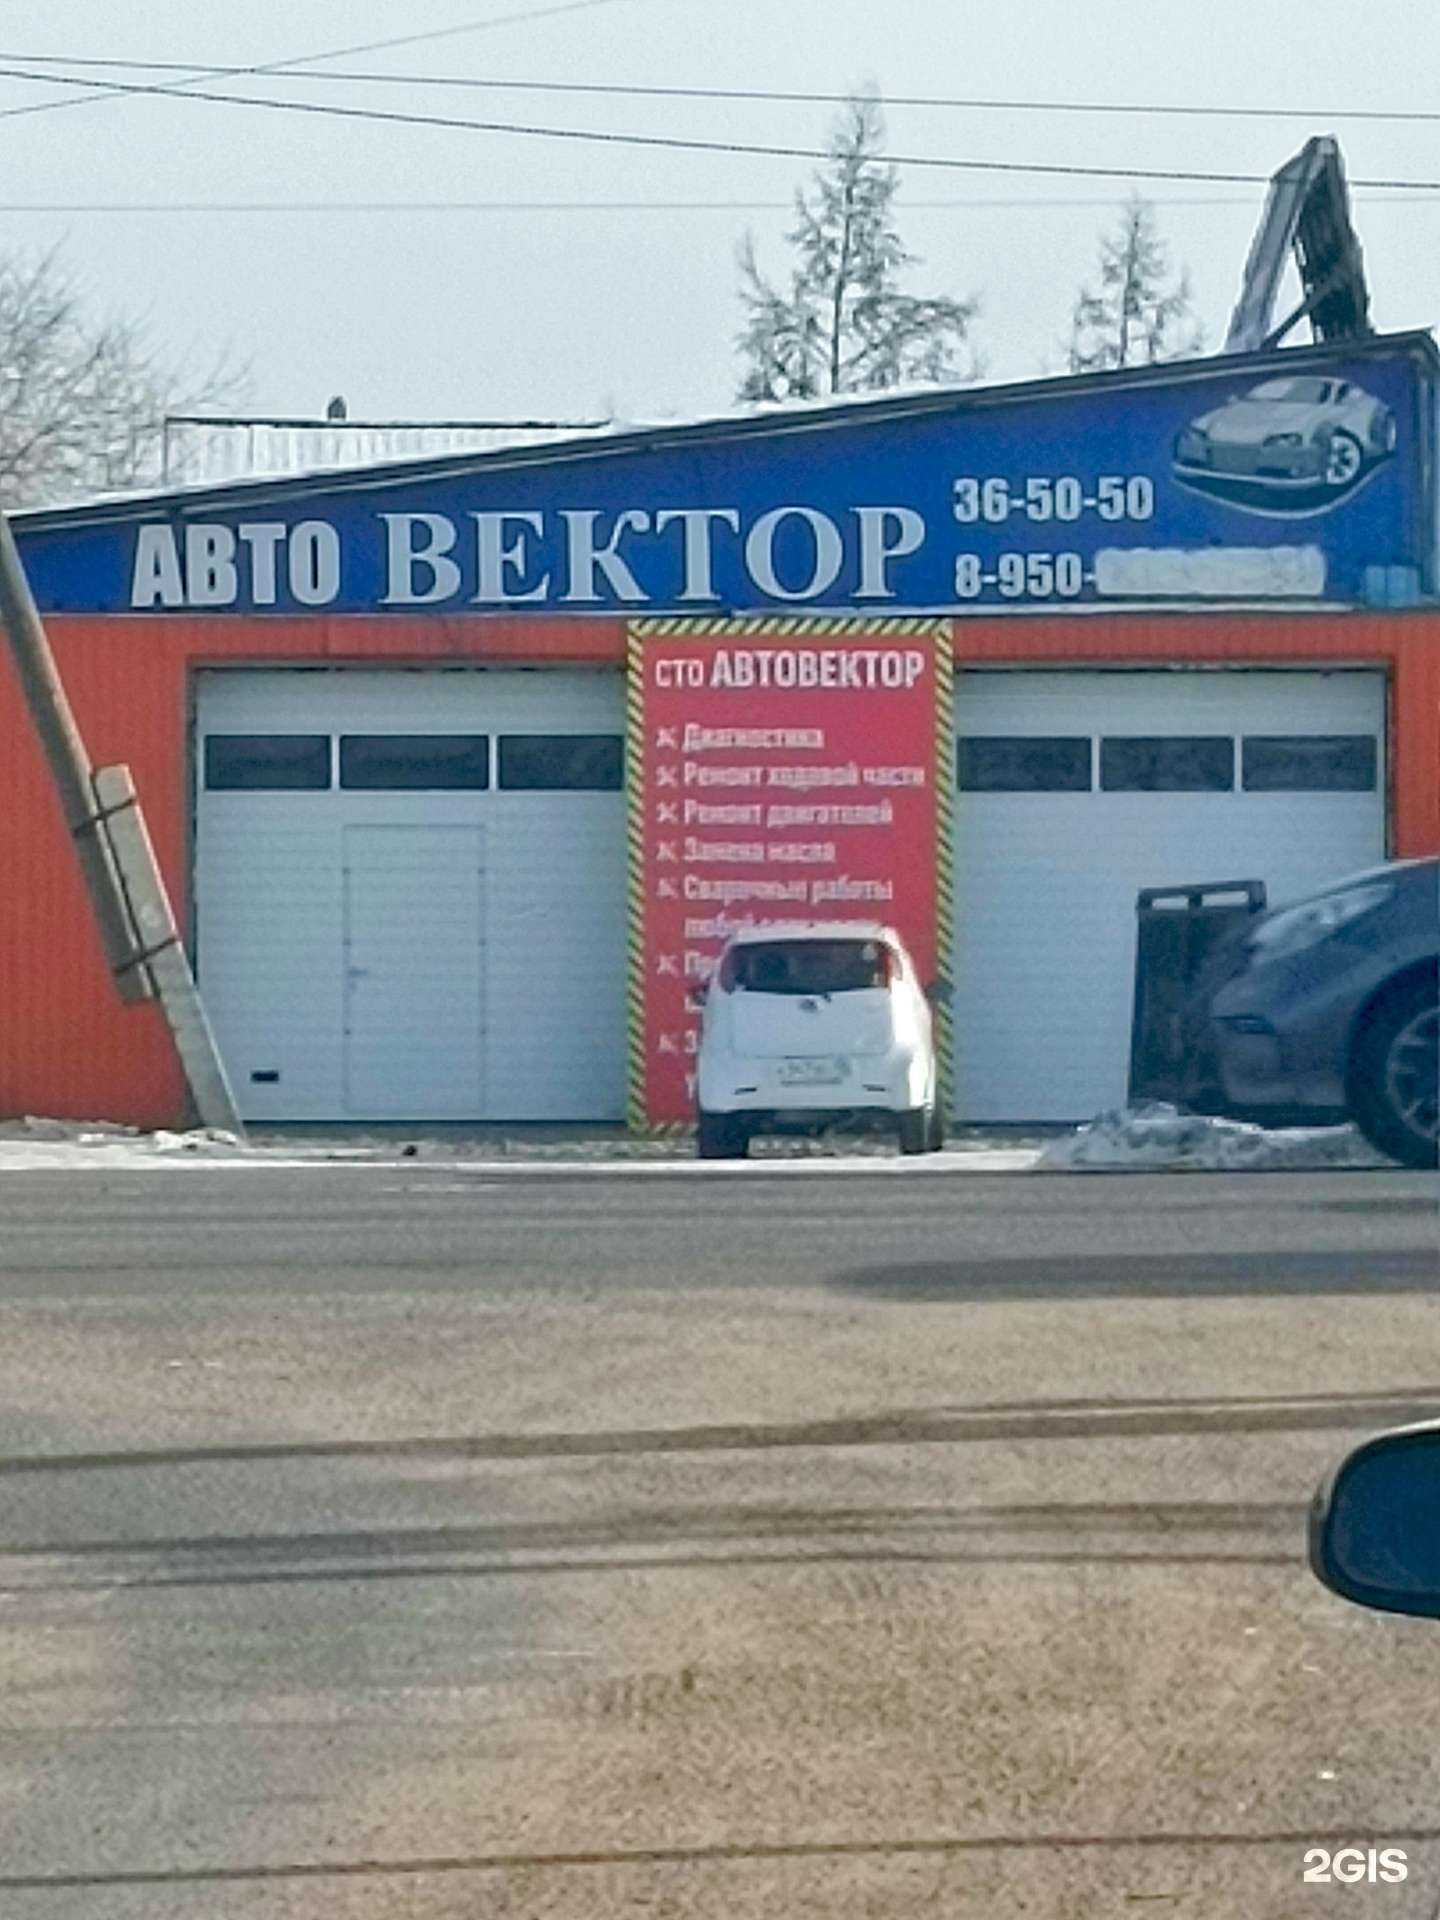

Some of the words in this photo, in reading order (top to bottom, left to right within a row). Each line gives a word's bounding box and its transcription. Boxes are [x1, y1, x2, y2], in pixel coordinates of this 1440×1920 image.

[953, 475, 1155, 523] 36-50-50
[131, 520, 341, 607] АВТО
[376, 506, 926, 605] ВЕКТОР
[709, 650, 925, 688] АВТОВЕКТОР
[684, 761, 761, 786] Ремонт
[684, 799, 761, 825] Ремонт
